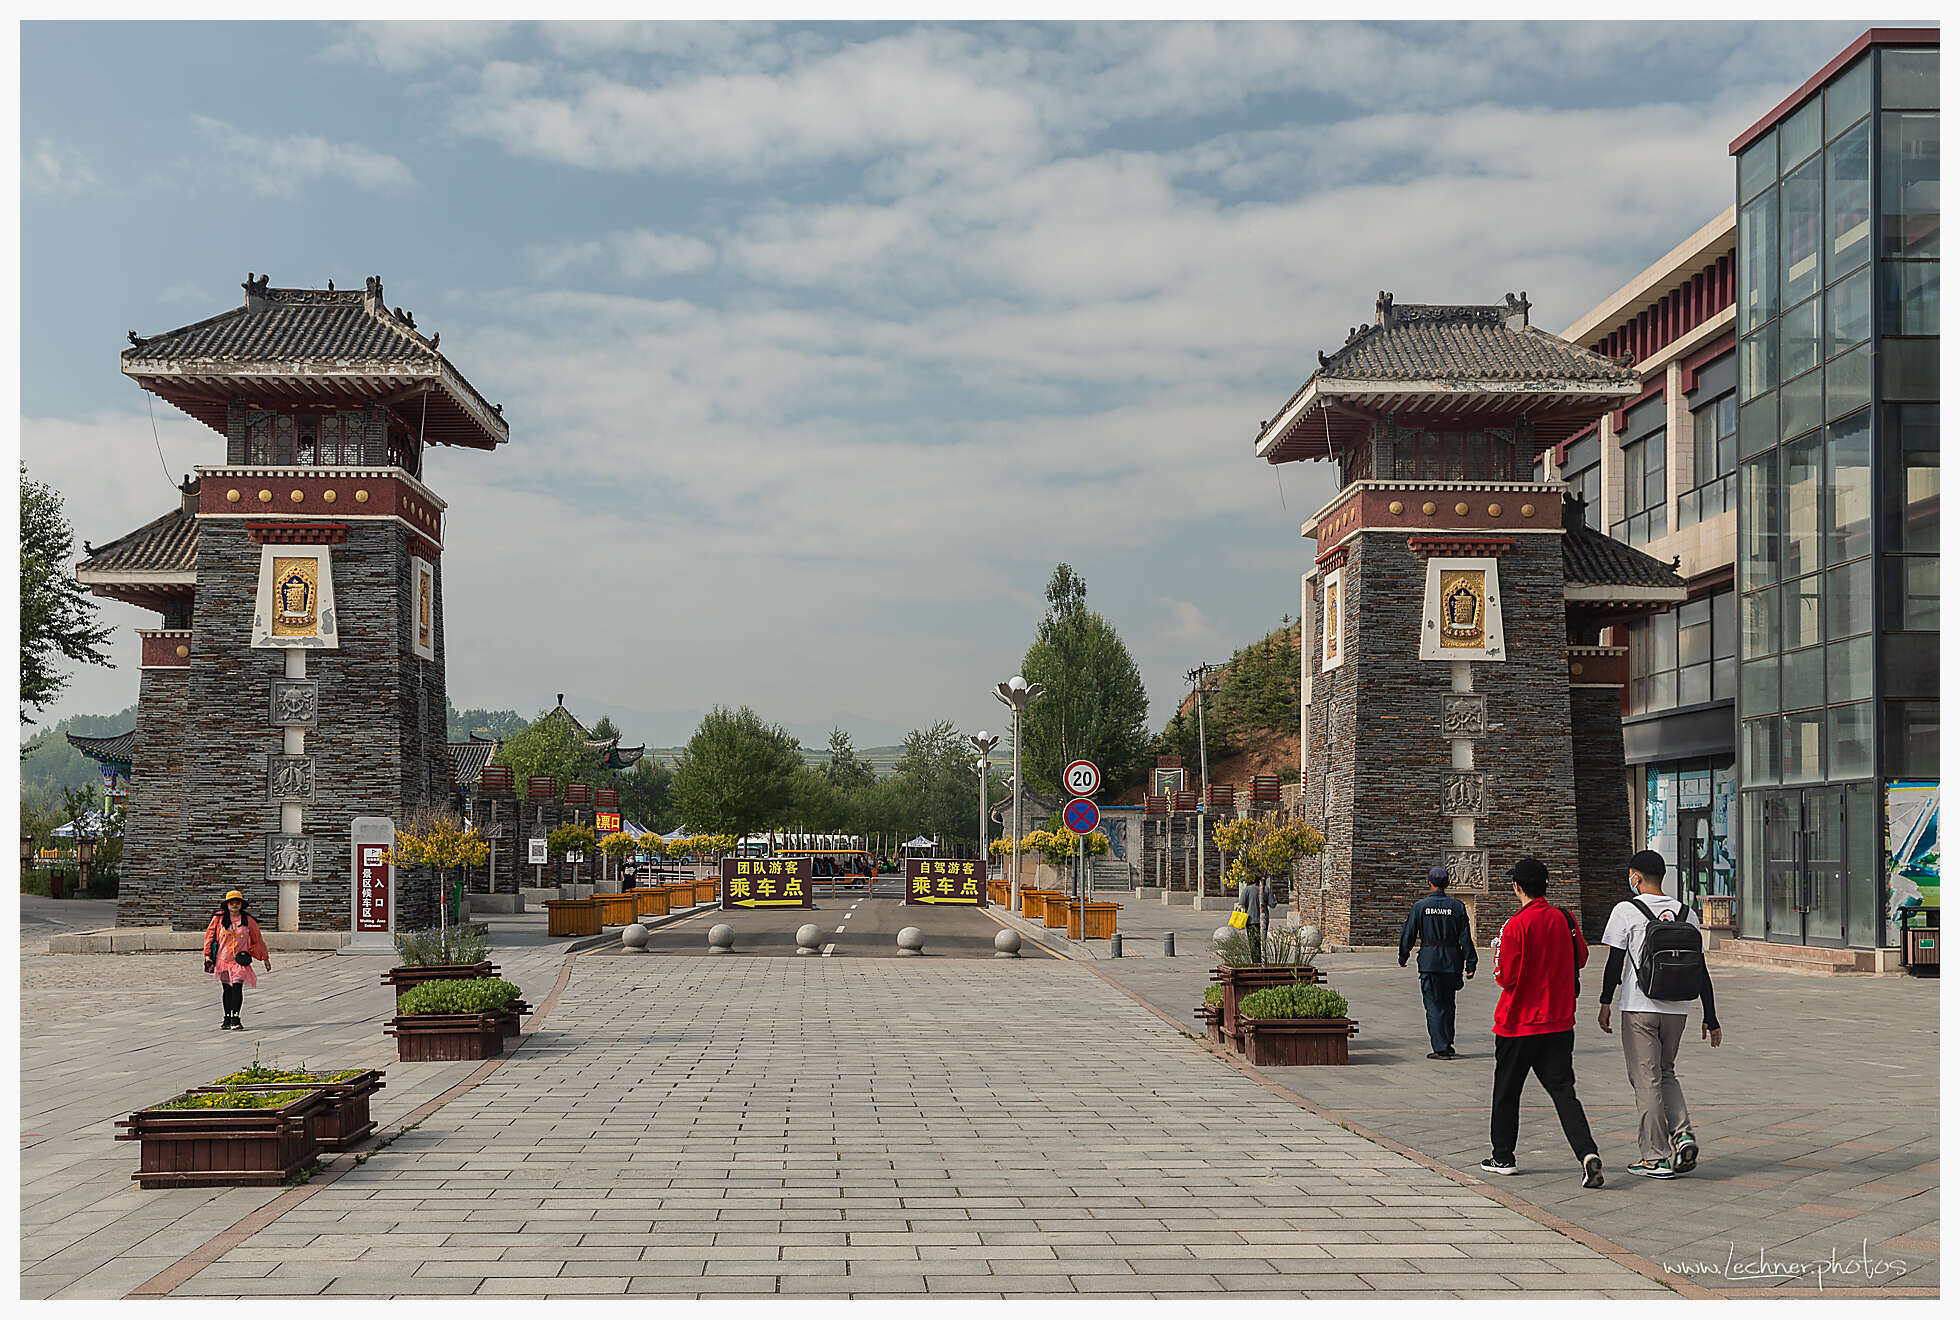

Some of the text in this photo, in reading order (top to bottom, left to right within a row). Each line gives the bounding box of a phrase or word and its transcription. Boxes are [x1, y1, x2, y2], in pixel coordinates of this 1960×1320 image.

[1073, 771, 1092, 787] 20
[737, 861, 798, 874] 团队游客
[921, 861, 974, 874] 自驾游客
[362, 868, 372, 917] 景区候车区
[375, 878, 384, 907] 入口
[730, 877, 804, 897] 乘车点
[912, 876, 979, 895] 乘车点
